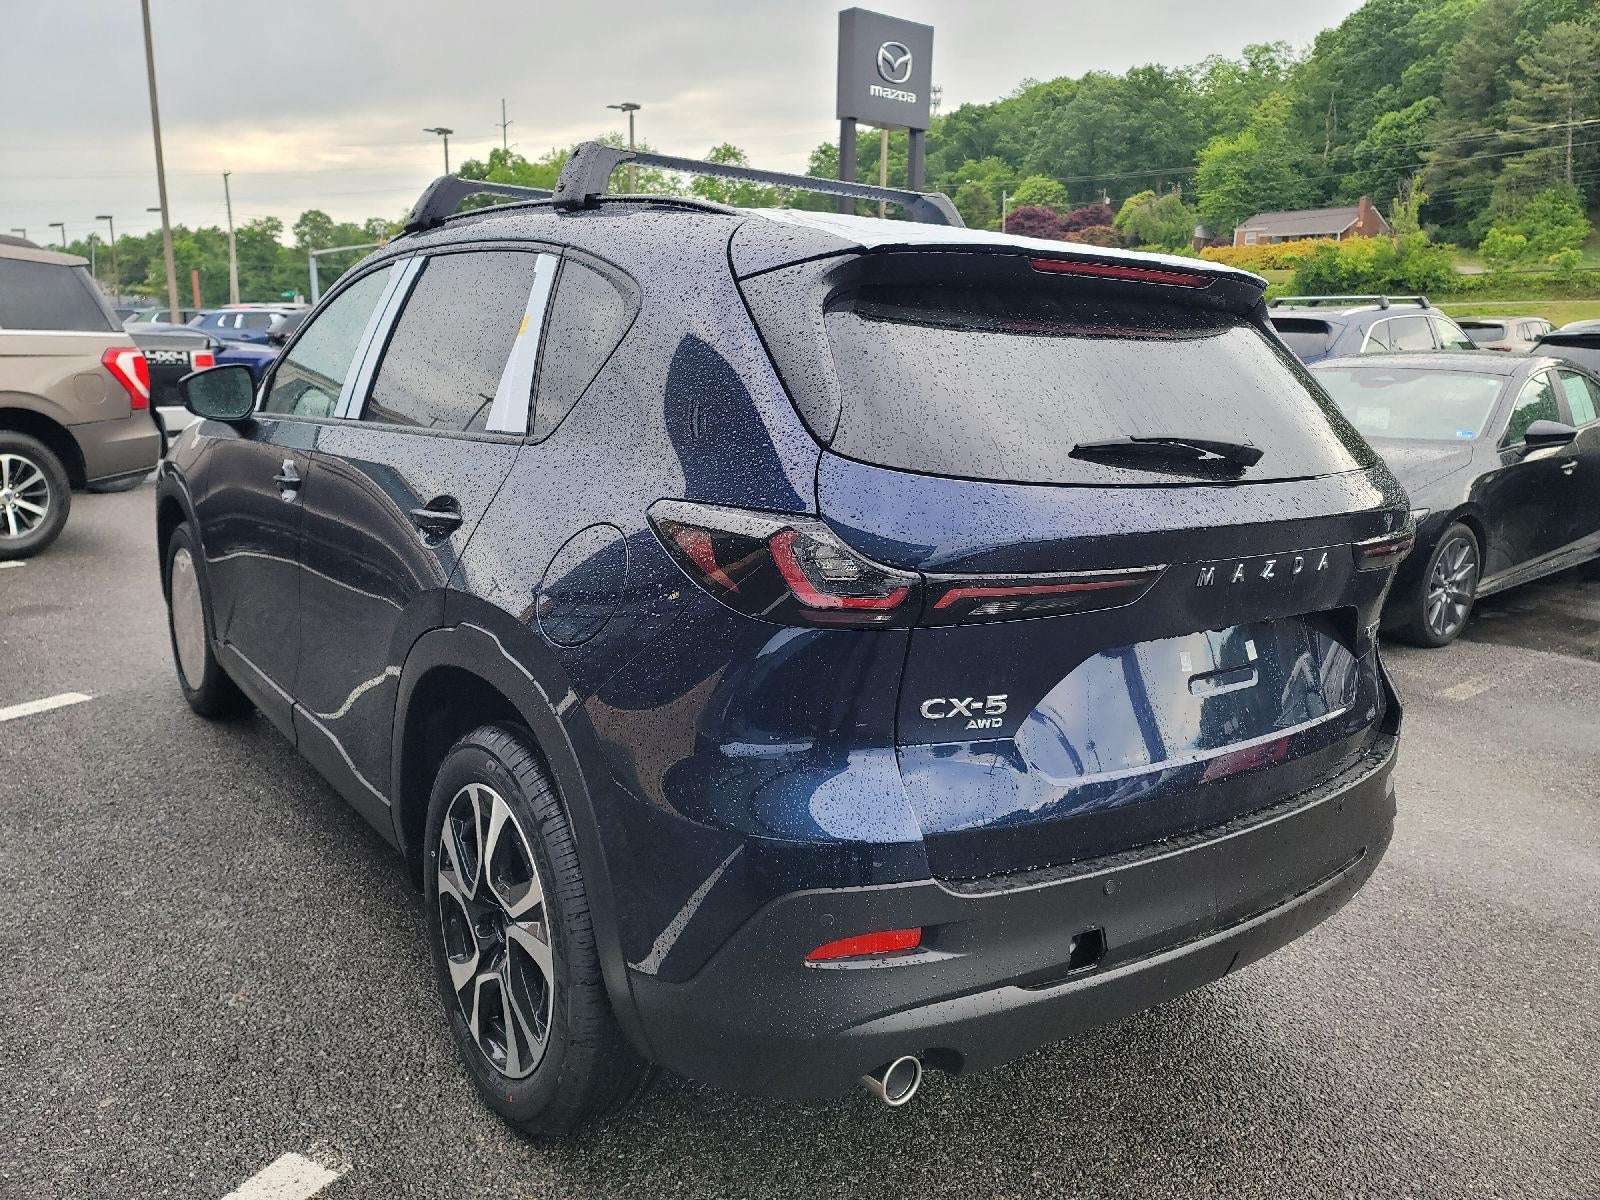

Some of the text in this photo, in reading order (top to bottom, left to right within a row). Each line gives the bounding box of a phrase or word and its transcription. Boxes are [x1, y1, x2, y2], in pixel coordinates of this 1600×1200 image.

[1195, 552, 1329, 587] MAZDA
[920, 694, 1008, 719] CX-5
[965, 717, 1003, 730] AWD
